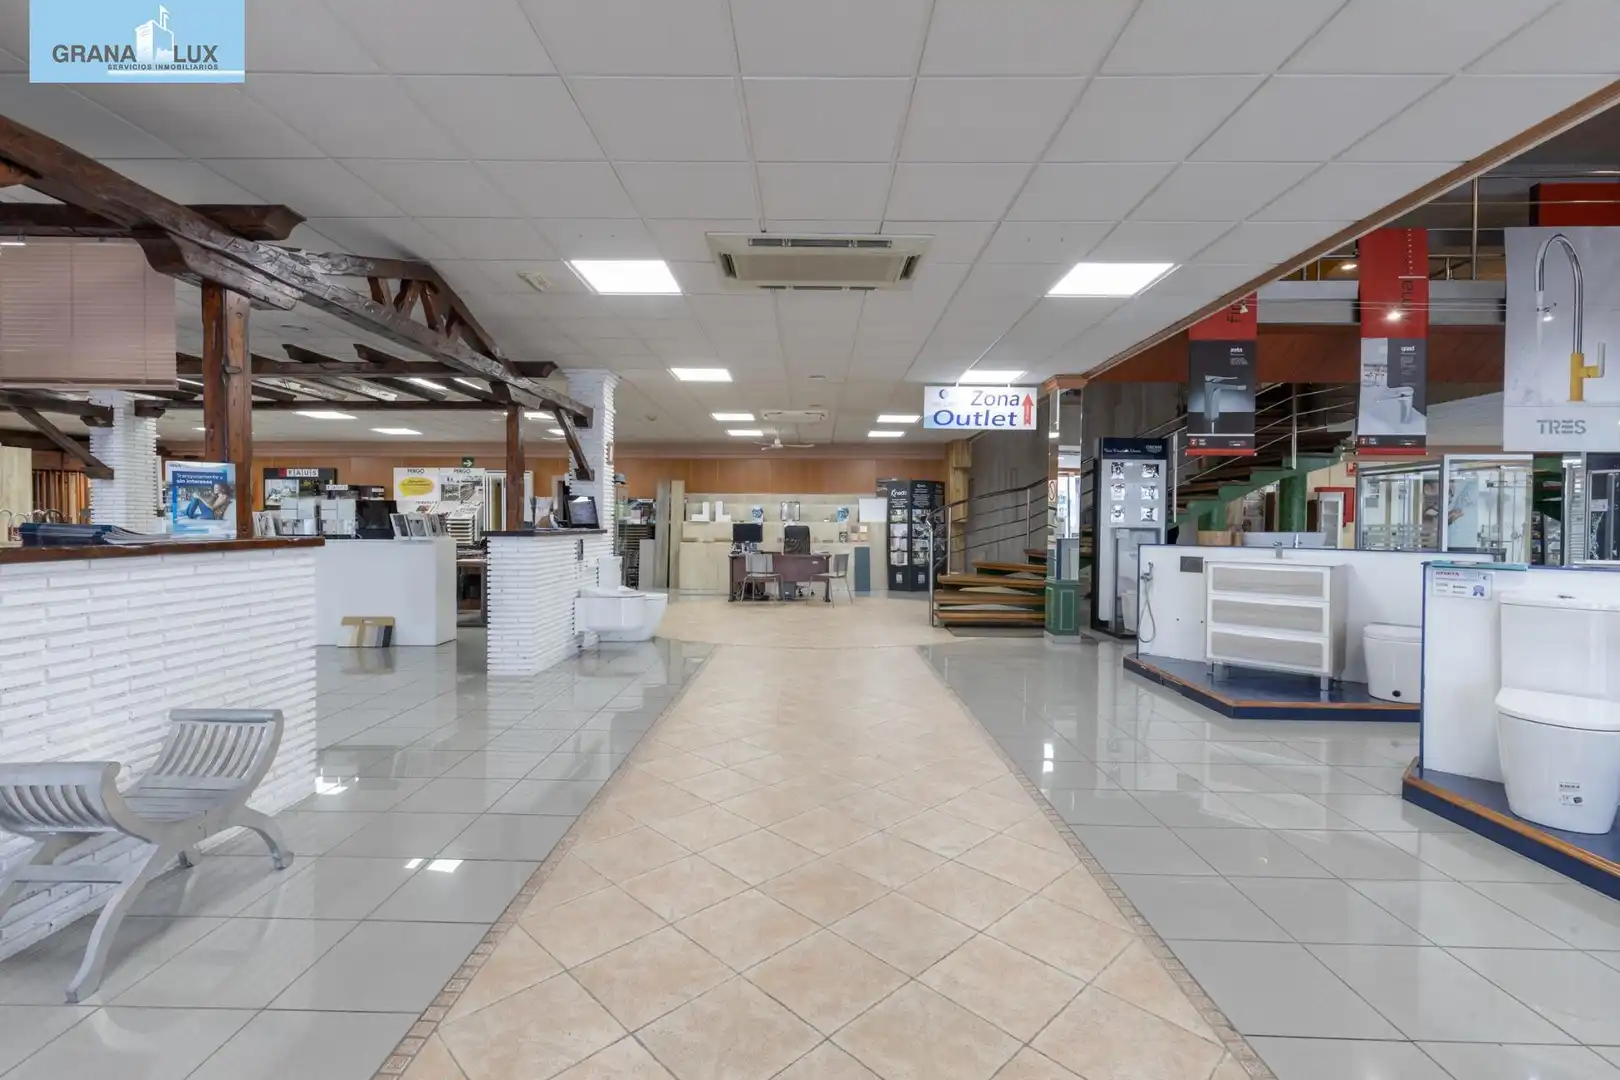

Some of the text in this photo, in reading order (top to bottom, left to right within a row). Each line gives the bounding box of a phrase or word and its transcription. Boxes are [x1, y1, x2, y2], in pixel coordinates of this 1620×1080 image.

[970, 390, 1020, 406] Zona
[933, 409, 1018, 426] Outlet
[1536, 419, 1587, 435] TRES
[288, 469, 317, 477] FAUS
